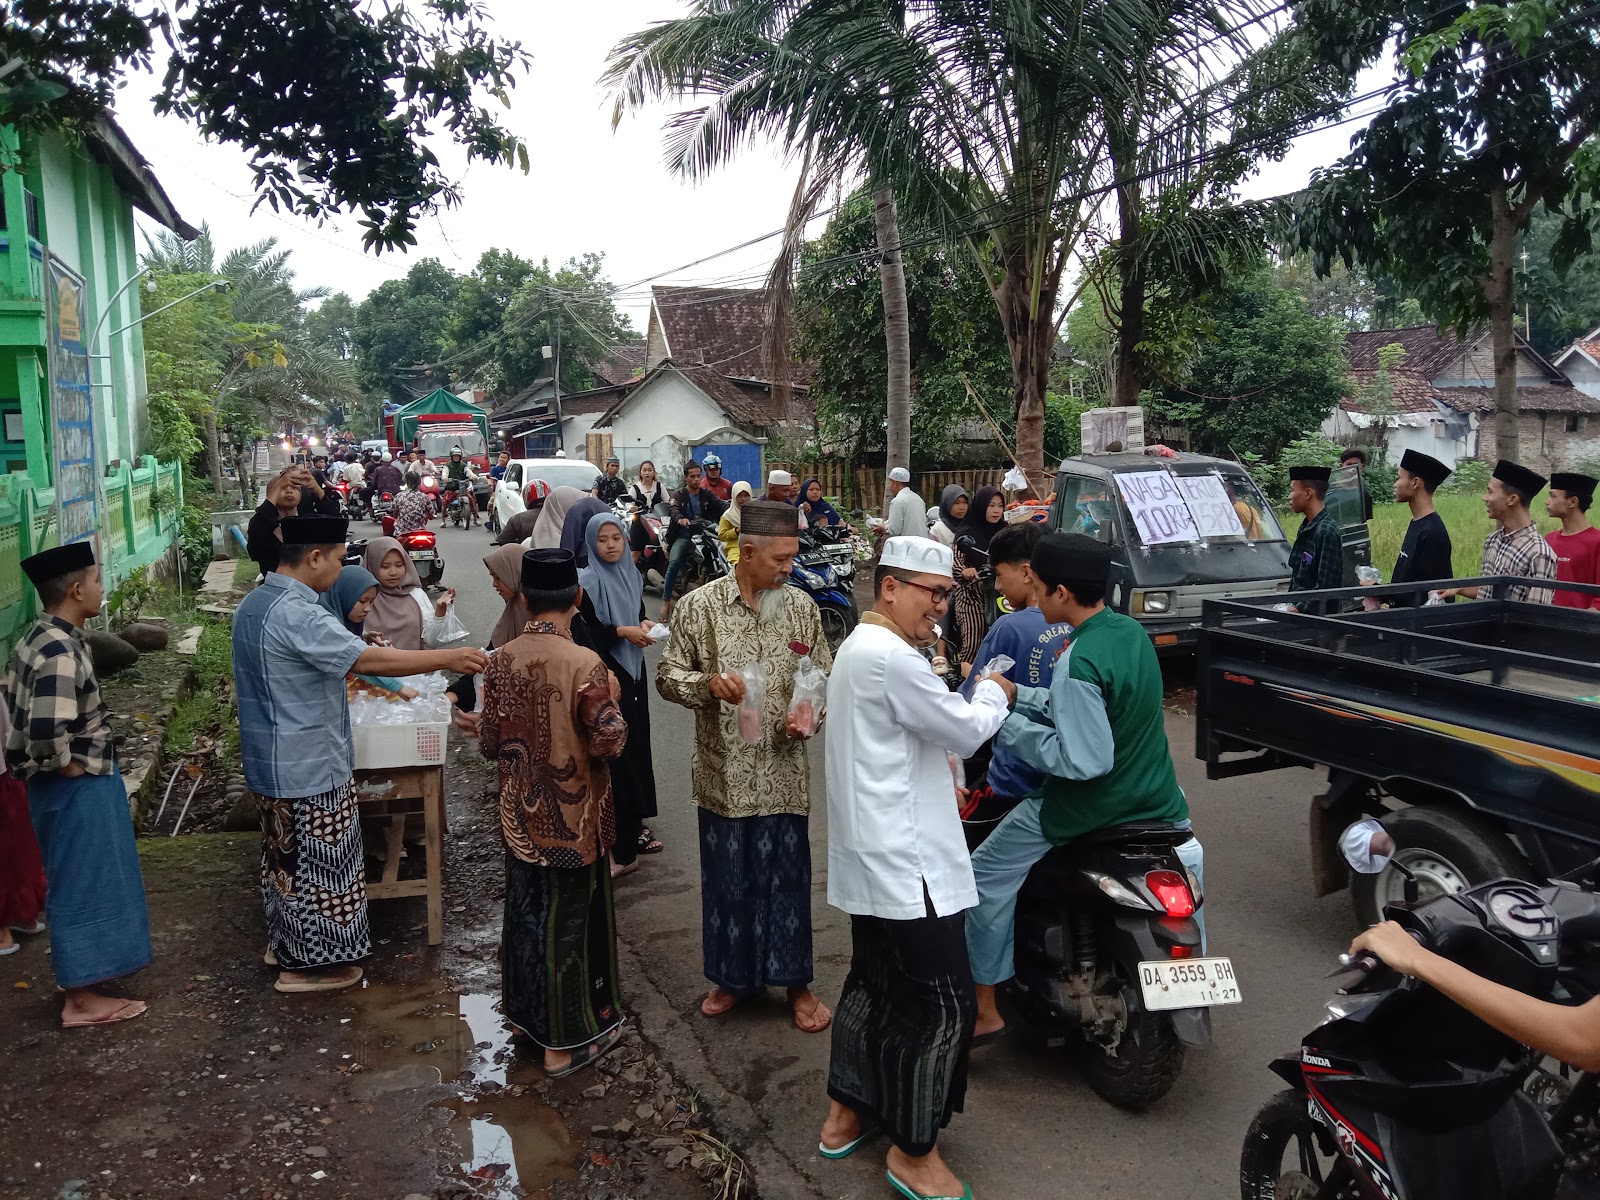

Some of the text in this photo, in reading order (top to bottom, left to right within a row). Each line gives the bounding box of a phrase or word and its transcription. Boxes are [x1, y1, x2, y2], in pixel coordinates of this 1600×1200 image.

[1118, 475, 1180, 505] NAGA
[1178, 478, 1222, 501] JERUK
[1029, 647, 1043, 684] COFFEE
[1039, 625, 1071, 644] BREAK
[1143, 962, 1234, 986] DA 3559 BH
